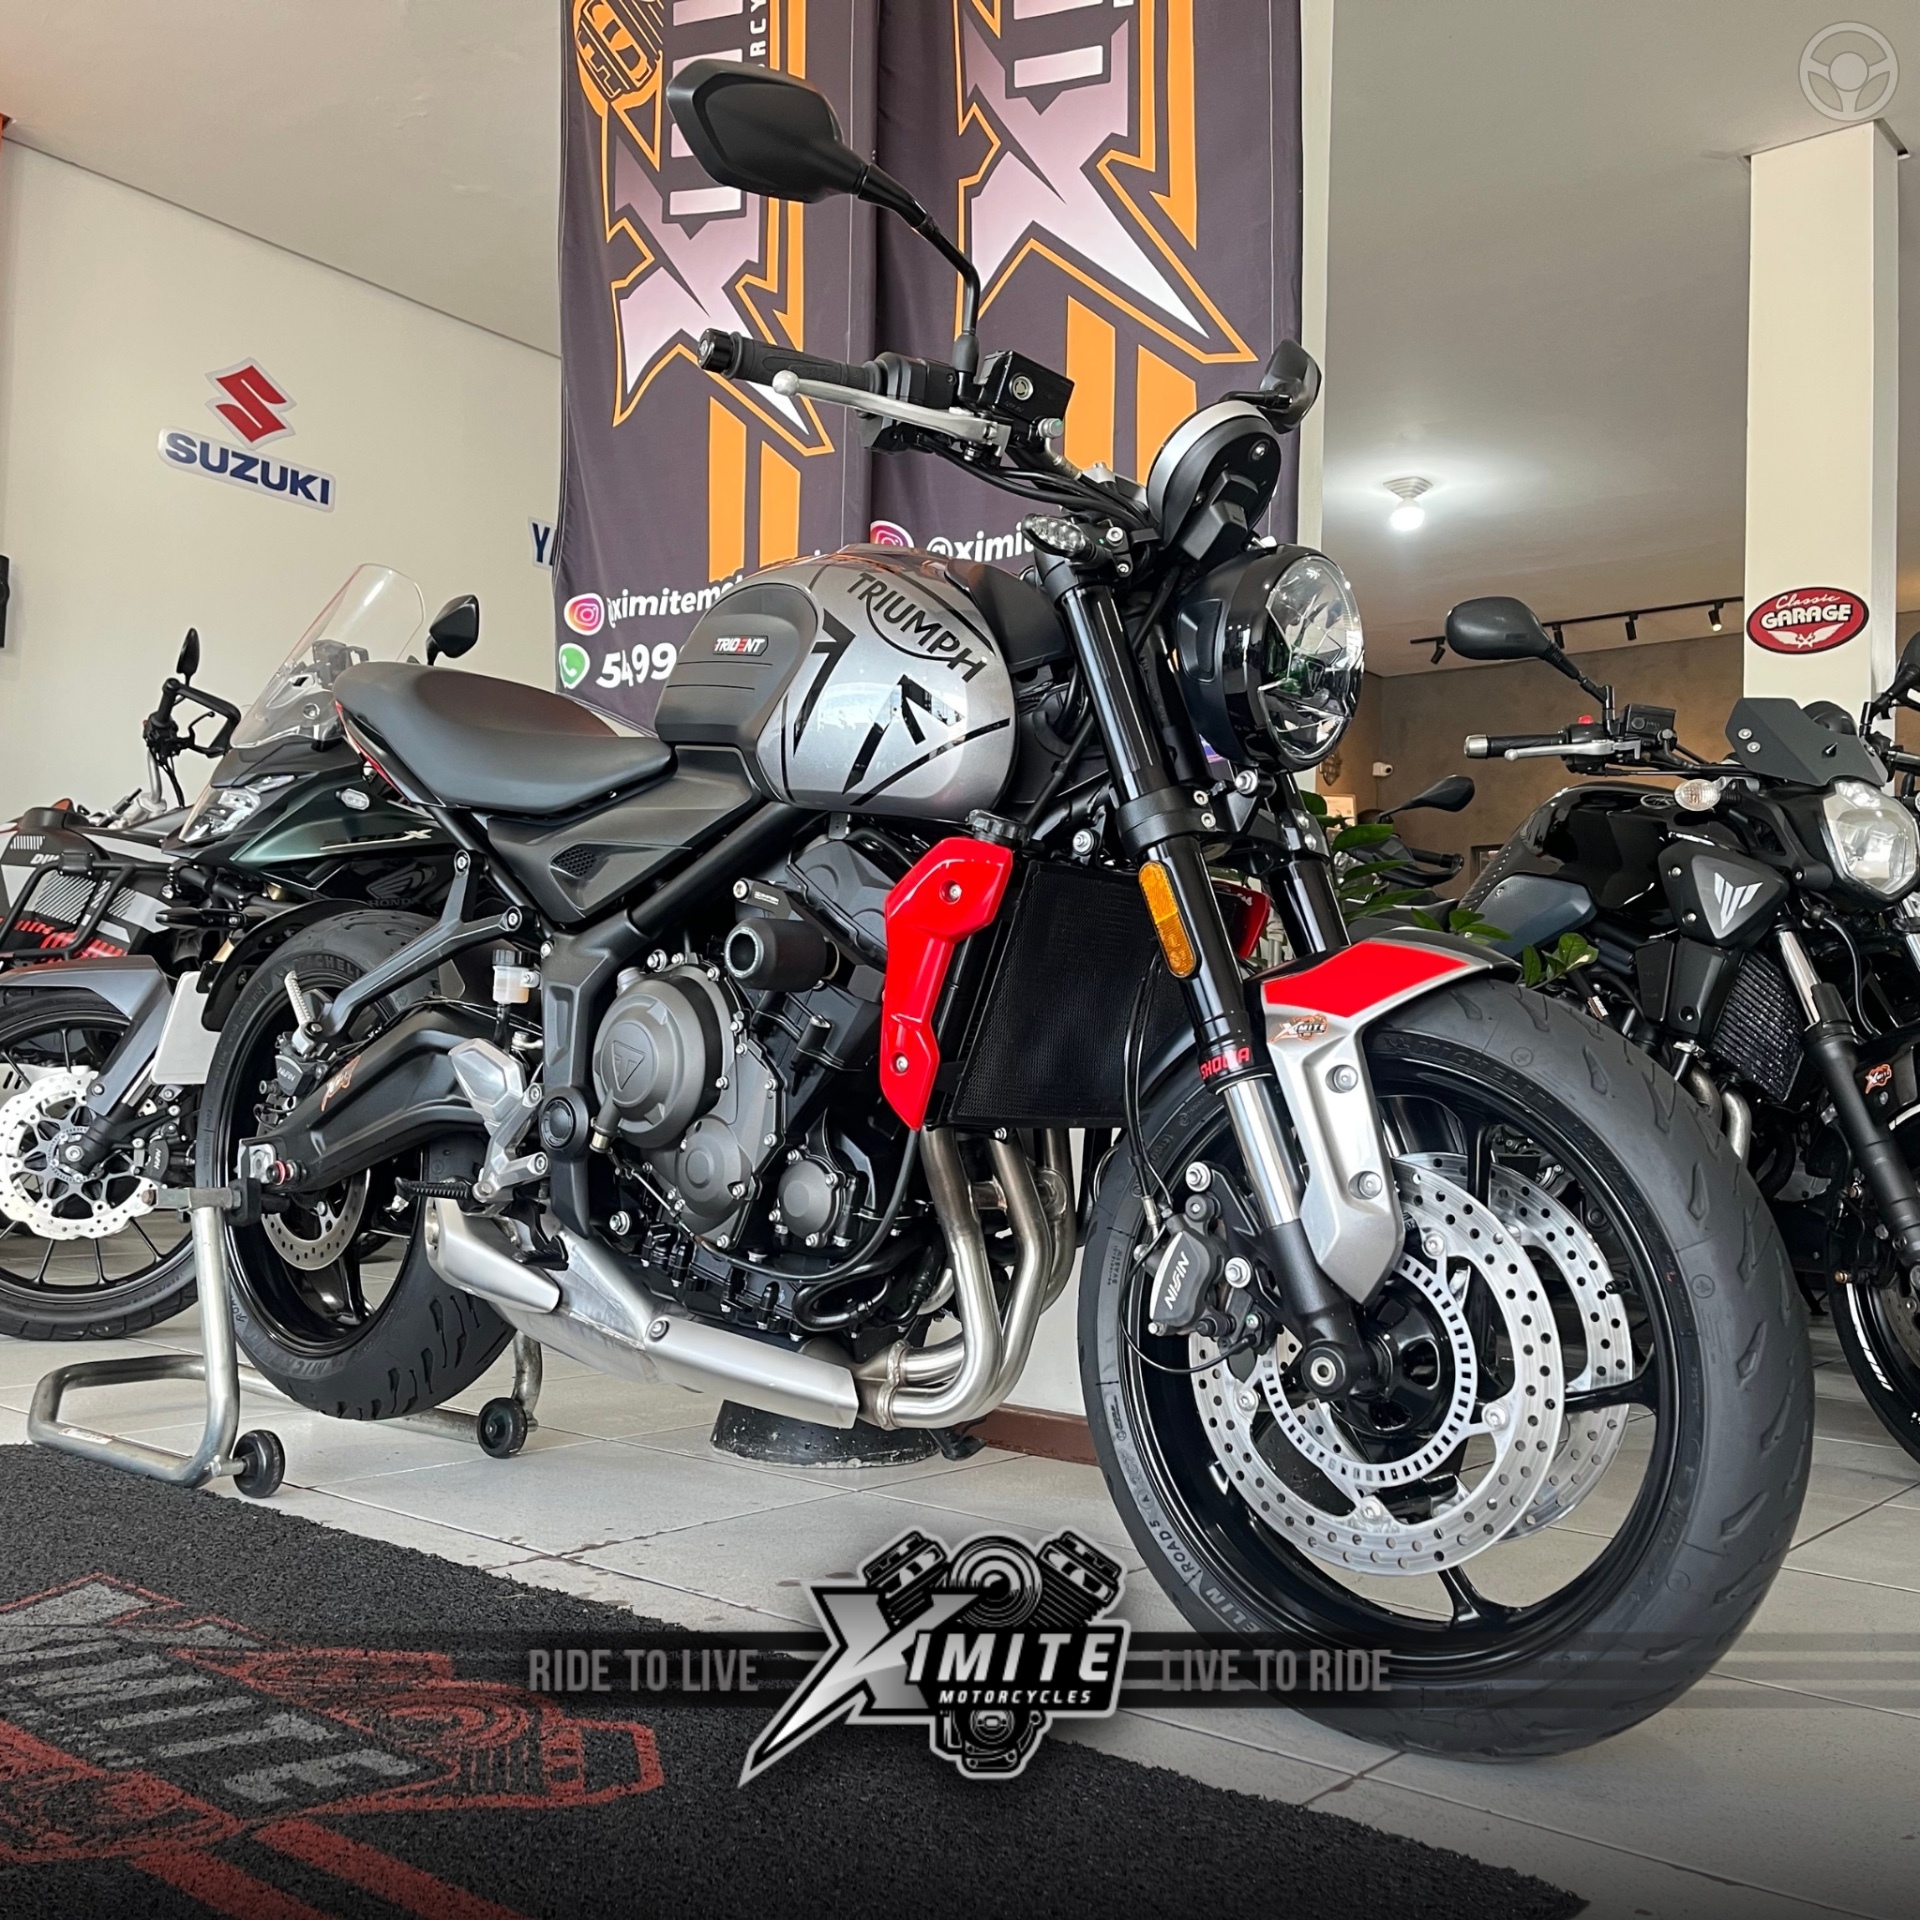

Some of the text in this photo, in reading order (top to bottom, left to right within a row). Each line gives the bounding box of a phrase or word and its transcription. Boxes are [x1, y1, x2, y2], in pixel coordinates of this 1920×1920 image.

[165, 433, 330, 505] SUZUKI
[532, 522, 556, 566] Y
[1761, 604, 1852, 630] GARAGE
[1776, 593, 1841, 610] Classic
[714, 637, 766, 654] TRIDENT
[847, 573, 987, 683] TRIUMPH
[595, 642, 679, 689] 5499
[1200, 1046, 1250, 1080] SHOA
[1158, 1528, 1196, 1574] ROAD
